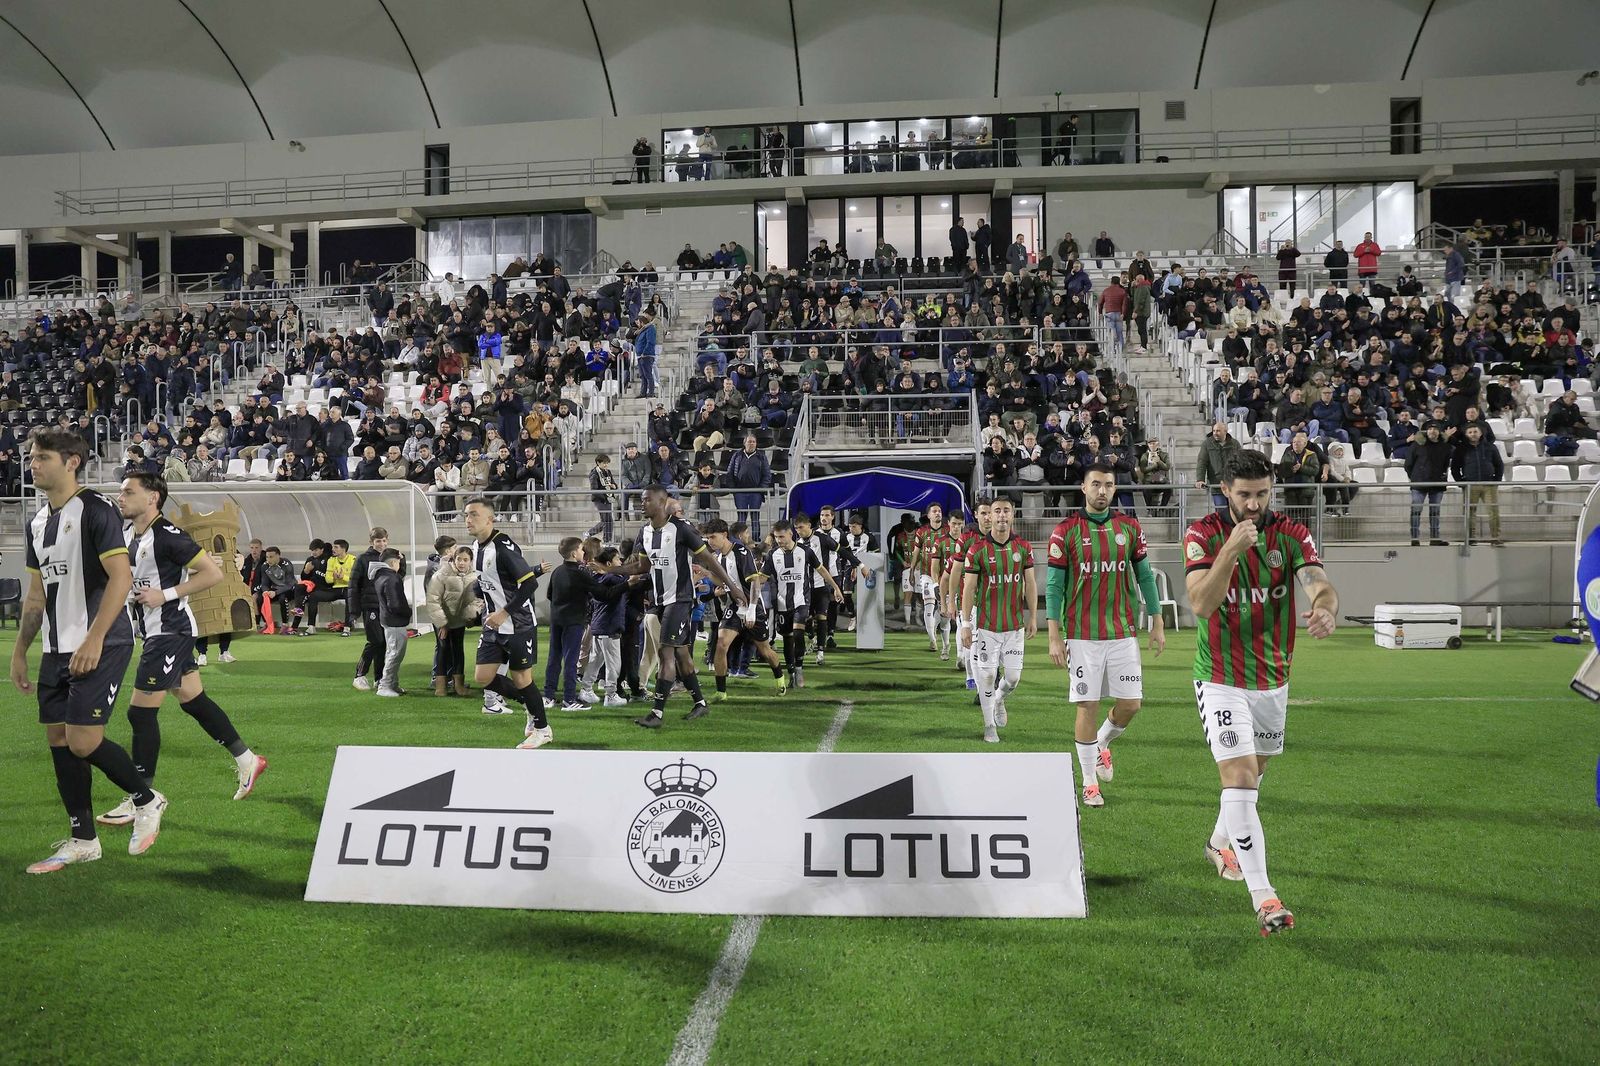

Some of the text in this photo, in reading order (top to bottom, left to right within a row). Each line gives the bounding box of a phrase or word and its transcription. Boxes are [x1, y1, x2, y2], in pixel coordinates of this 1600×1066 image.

[1080, 560, 1126, 573] NIMO
[780, 574, 802, 582] LOTUS
[988, 573, 1020, 584] NIMO
[981, 640, 987, 651] 2
[1076, 665, 1084, 679] 6
[1214, 710, 1232, 727] 18
[630, 798, 722, 850] REAL BALOMPEDICA
[337, 822, 552, 871] LOTUS
[803, 832, 1031, 879] LOTUS
[648, 872, 703, 890] LINENSE
